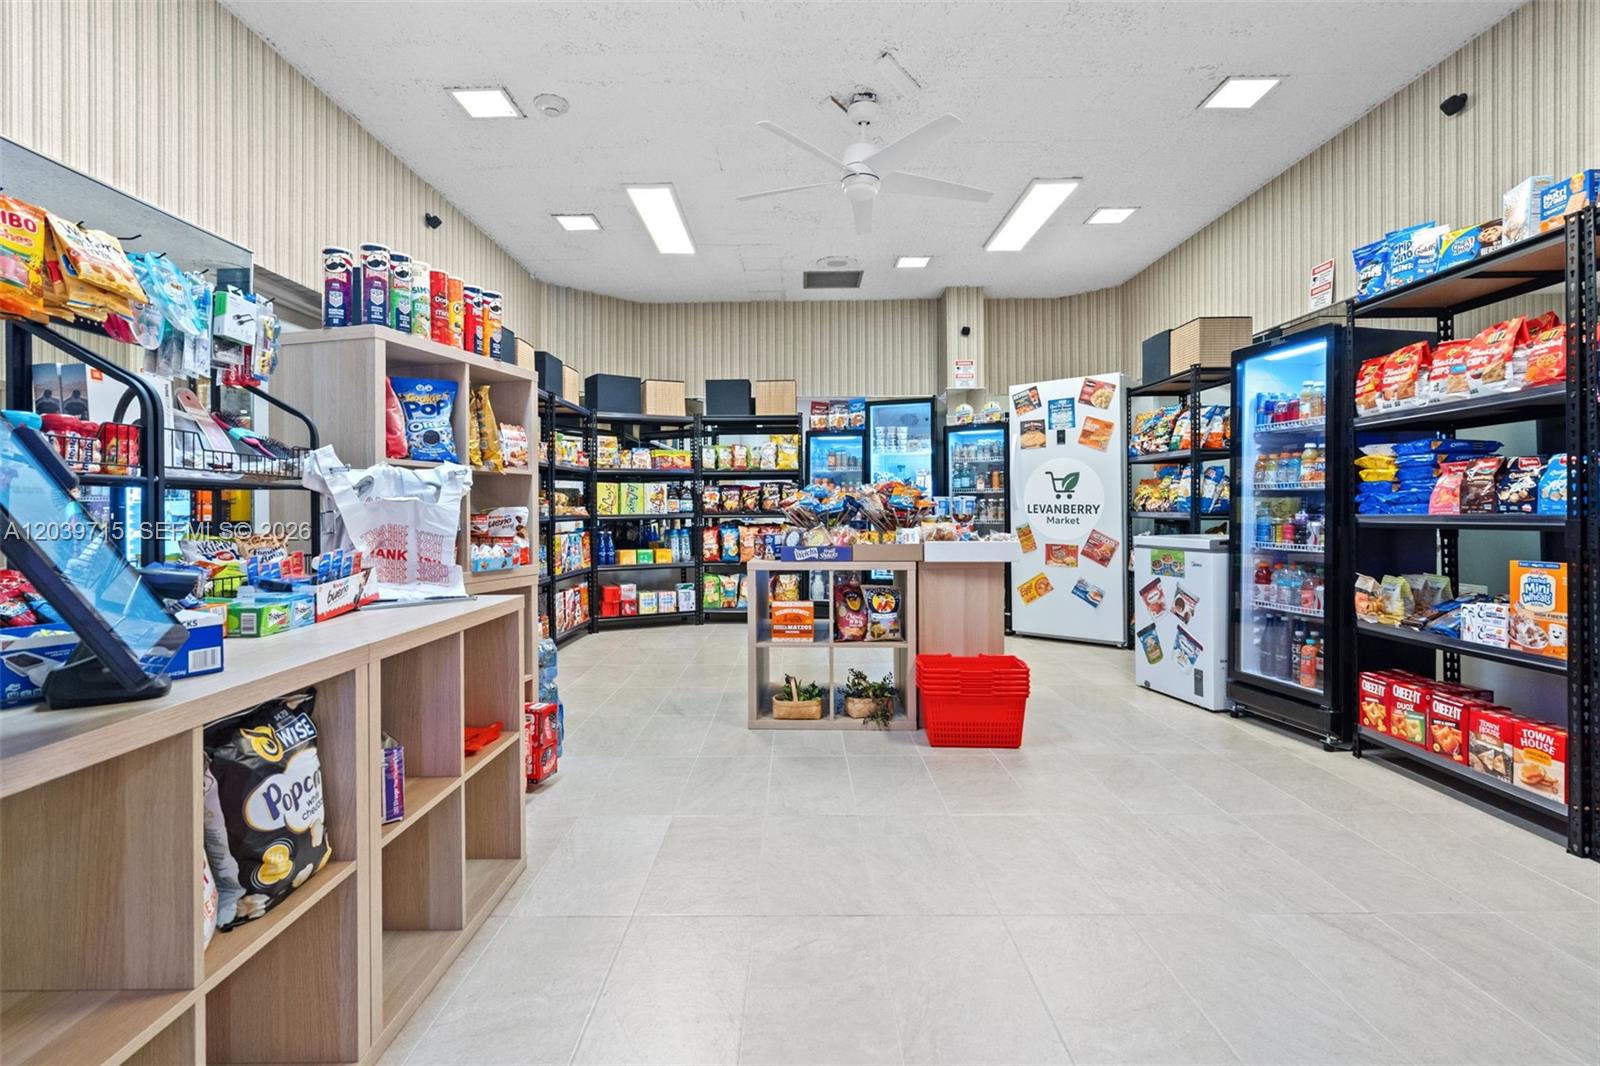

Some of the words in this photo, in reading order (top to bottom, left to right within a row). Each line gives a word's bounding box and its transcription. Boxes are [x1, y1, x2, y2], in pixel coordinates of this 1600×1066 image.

[1543, 185, 1567, 202] Nutri
[1543, 195, 1567, 209] Grain
[1027, 503, 1101, 514] LEVANBERRY
[488, 518, 512, 528] ueno
[1046, 516, 1080, 525] Market
[327, 585, 350, 604] bueno
[1524, 583, 1551, 595] Mini
[1522, 592, 1552, 605] Wheats
[1393, 684, 1421, 705] CHEEZ-IT
[1433, 700, 1462, 721] CHEEZ-IT
[276, 718, 314, 748] WISE
[1521, 729, 1554, 746] TOWN
[1520, 738, 1557, 756] HOUSE
